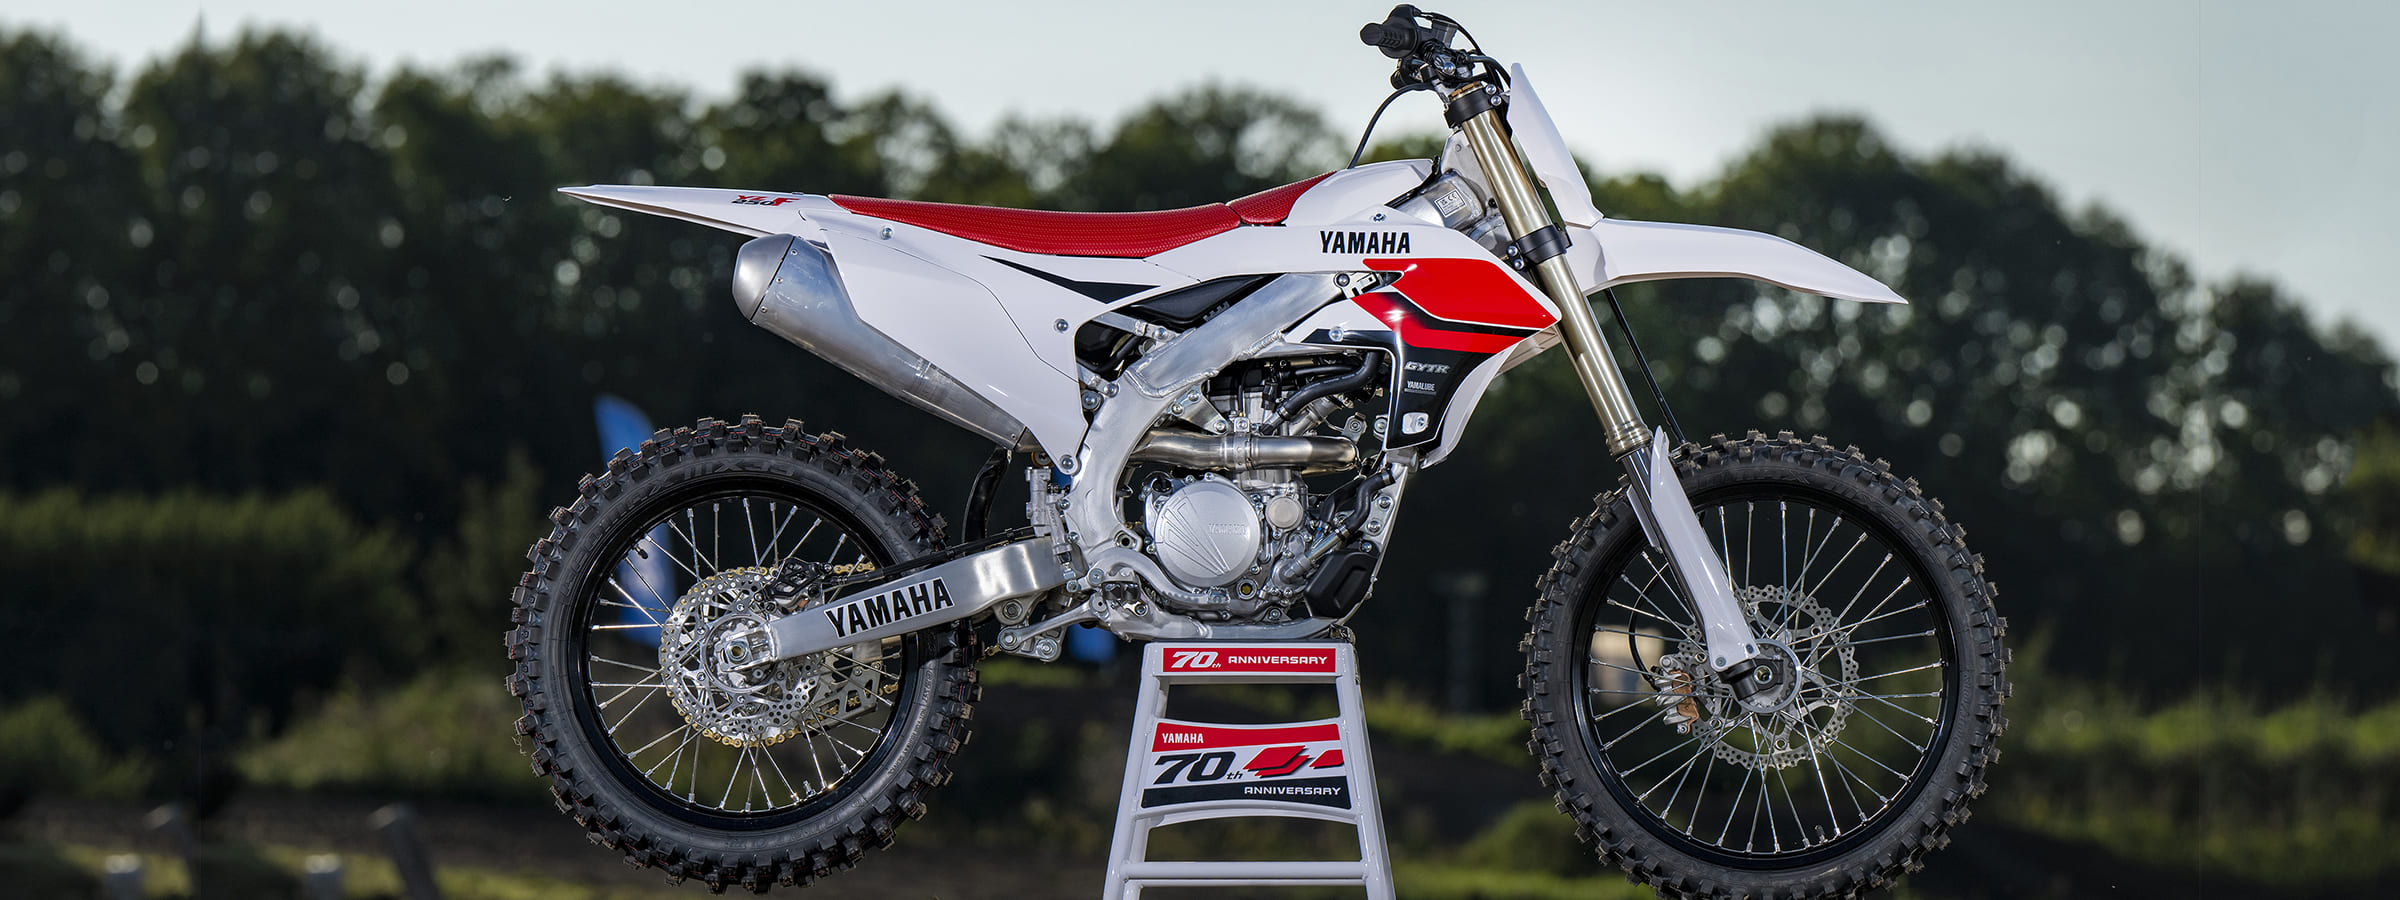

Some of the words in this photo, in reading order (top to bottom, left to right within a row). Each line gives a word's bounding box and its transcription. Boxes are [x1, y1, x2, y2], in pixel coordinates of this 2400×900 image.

[1320, 231, 1411, 254] YAMAHA
[1404, 361, 1451, 374] GYTR
[1407, 380, 1436, 392] YAMALUBE
[826, 579, 953, 638] YAMAHA
[1171, 651, 1221, 669] 70th
[1228, 656, 1328, 665] ANNIVERSARY
[1162, 733, 1204, 744] YAMAHA
[1153, 752, 1243, 785] 70th
[1244, 786, 1341, 796] ANNIVERSARY
